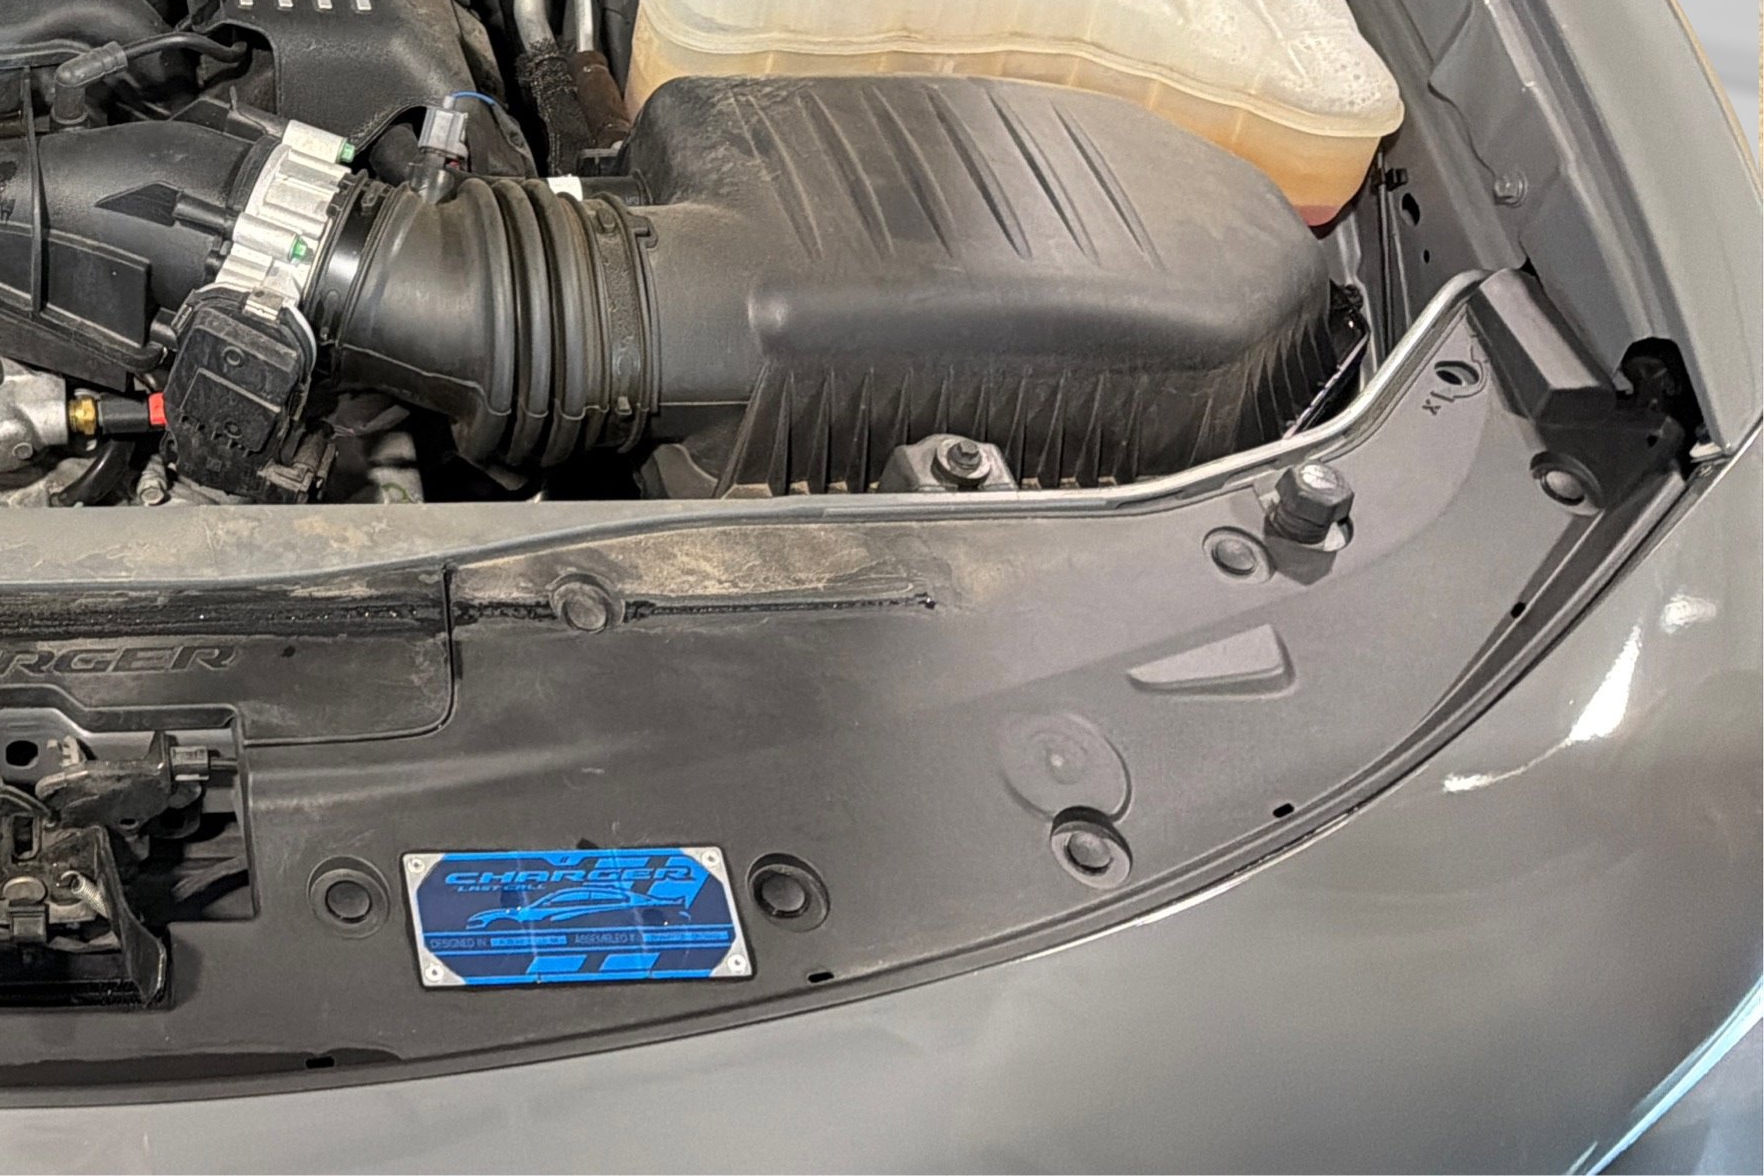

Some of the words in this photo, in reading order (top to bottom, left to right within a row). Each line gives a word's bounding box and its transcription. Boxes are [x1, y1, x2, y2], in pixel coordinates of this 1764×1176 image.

[445, 866, 696, 885] CHARGER
[456, 885, 499, 893] LAST
[500, 883, 547, 892] CALL
